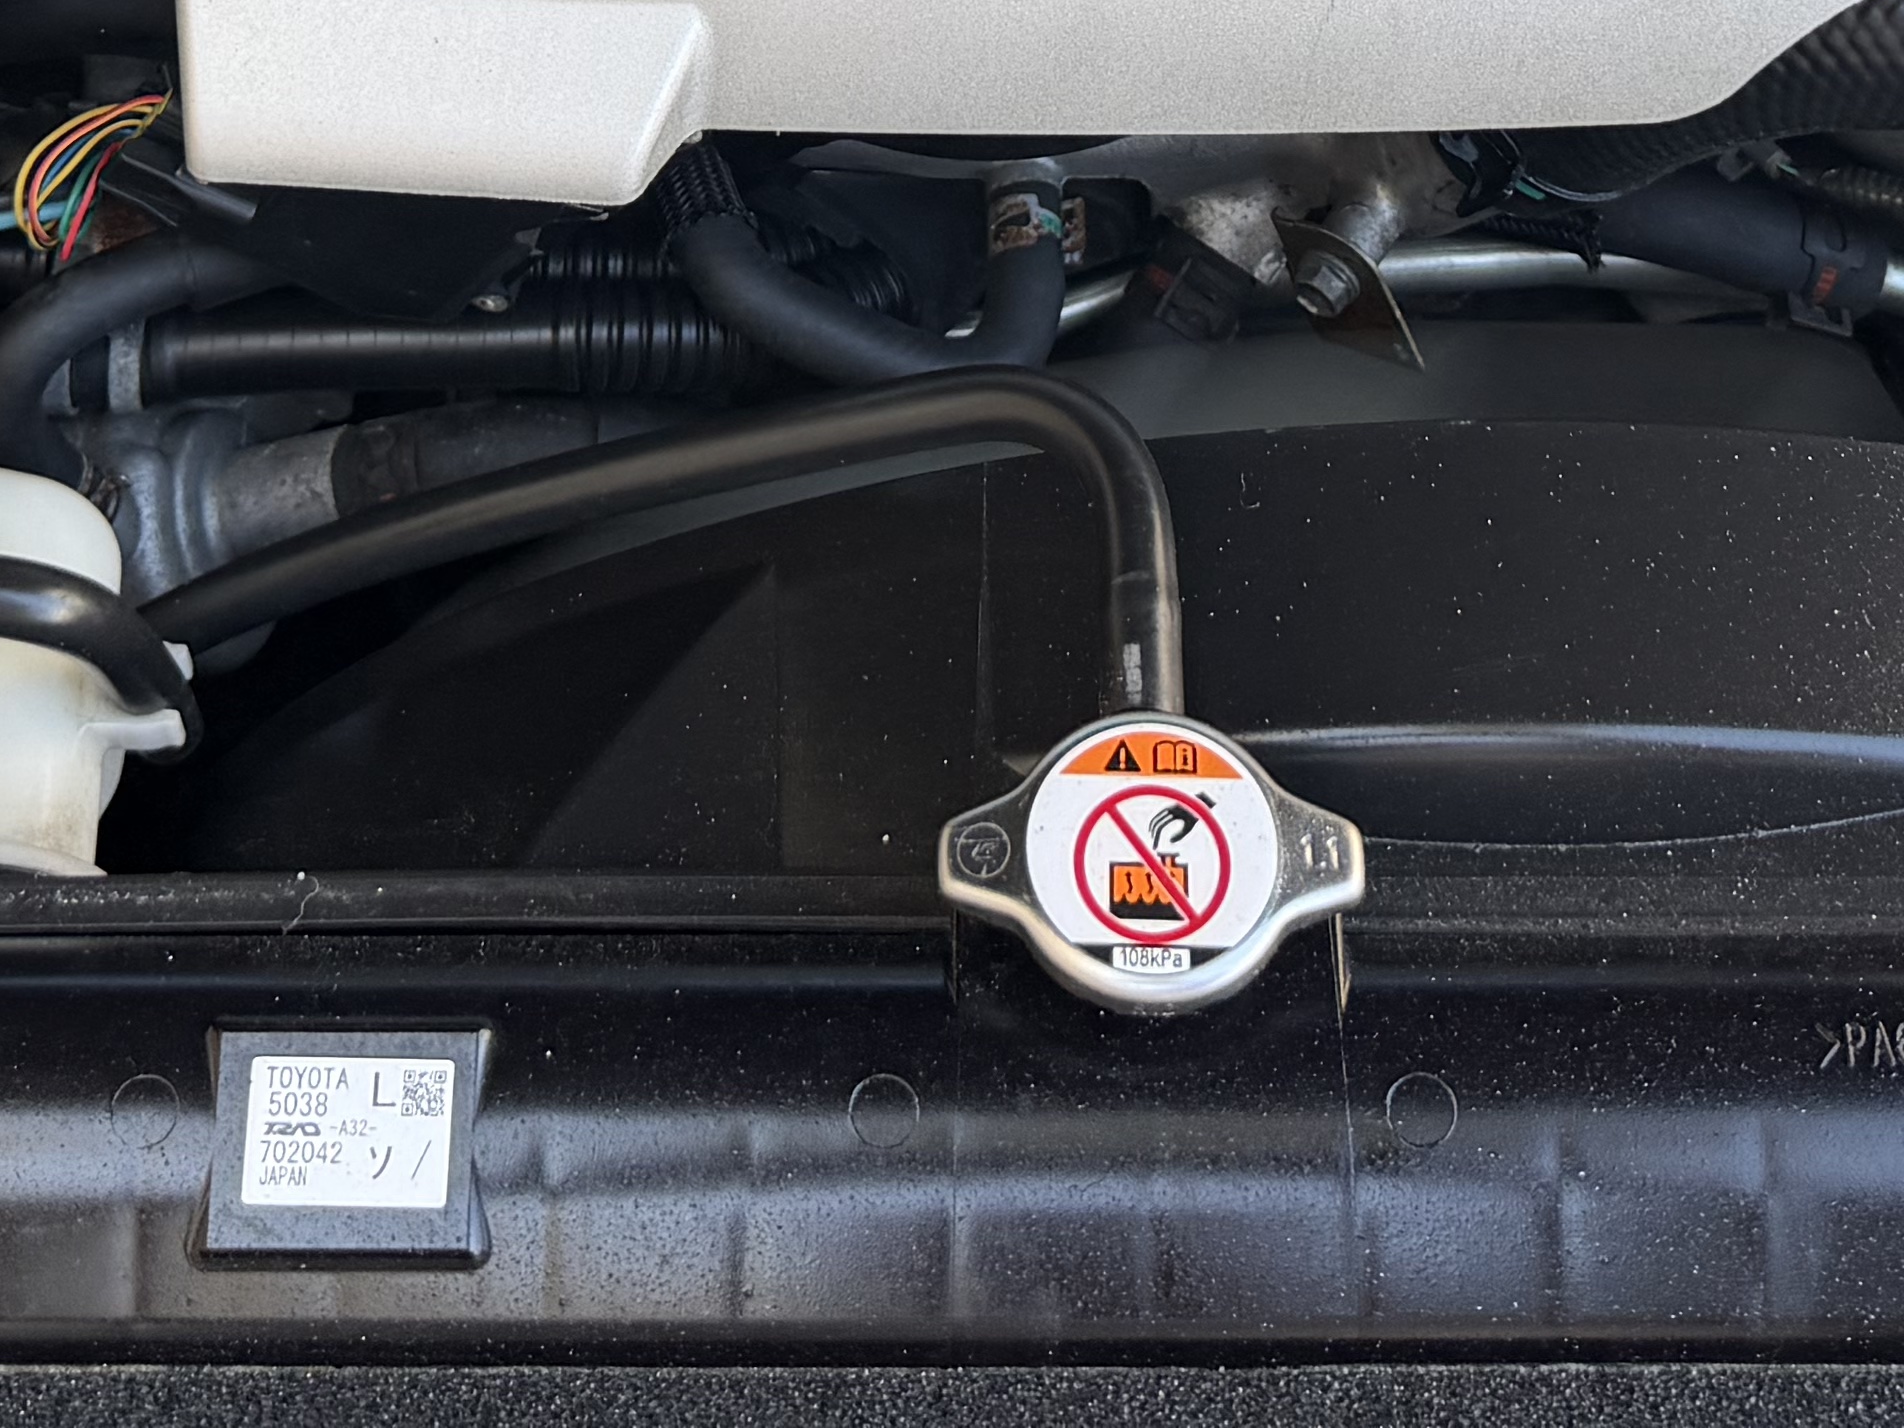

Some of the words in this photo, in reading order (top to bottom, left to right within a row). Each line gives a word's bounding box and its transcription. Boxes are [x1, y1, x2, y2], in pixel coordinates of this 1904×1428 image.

[1118, 948, 1183, 969] 108kPa
[266, 1066, 349, 1090] TOYOTA
[372, 1071, 396, 1107] L
[268, 1092, 328, 1117] 5038
[259, 1140, 343, 1164] 702042
[259, 1166, 308, 1186] JAPAN
